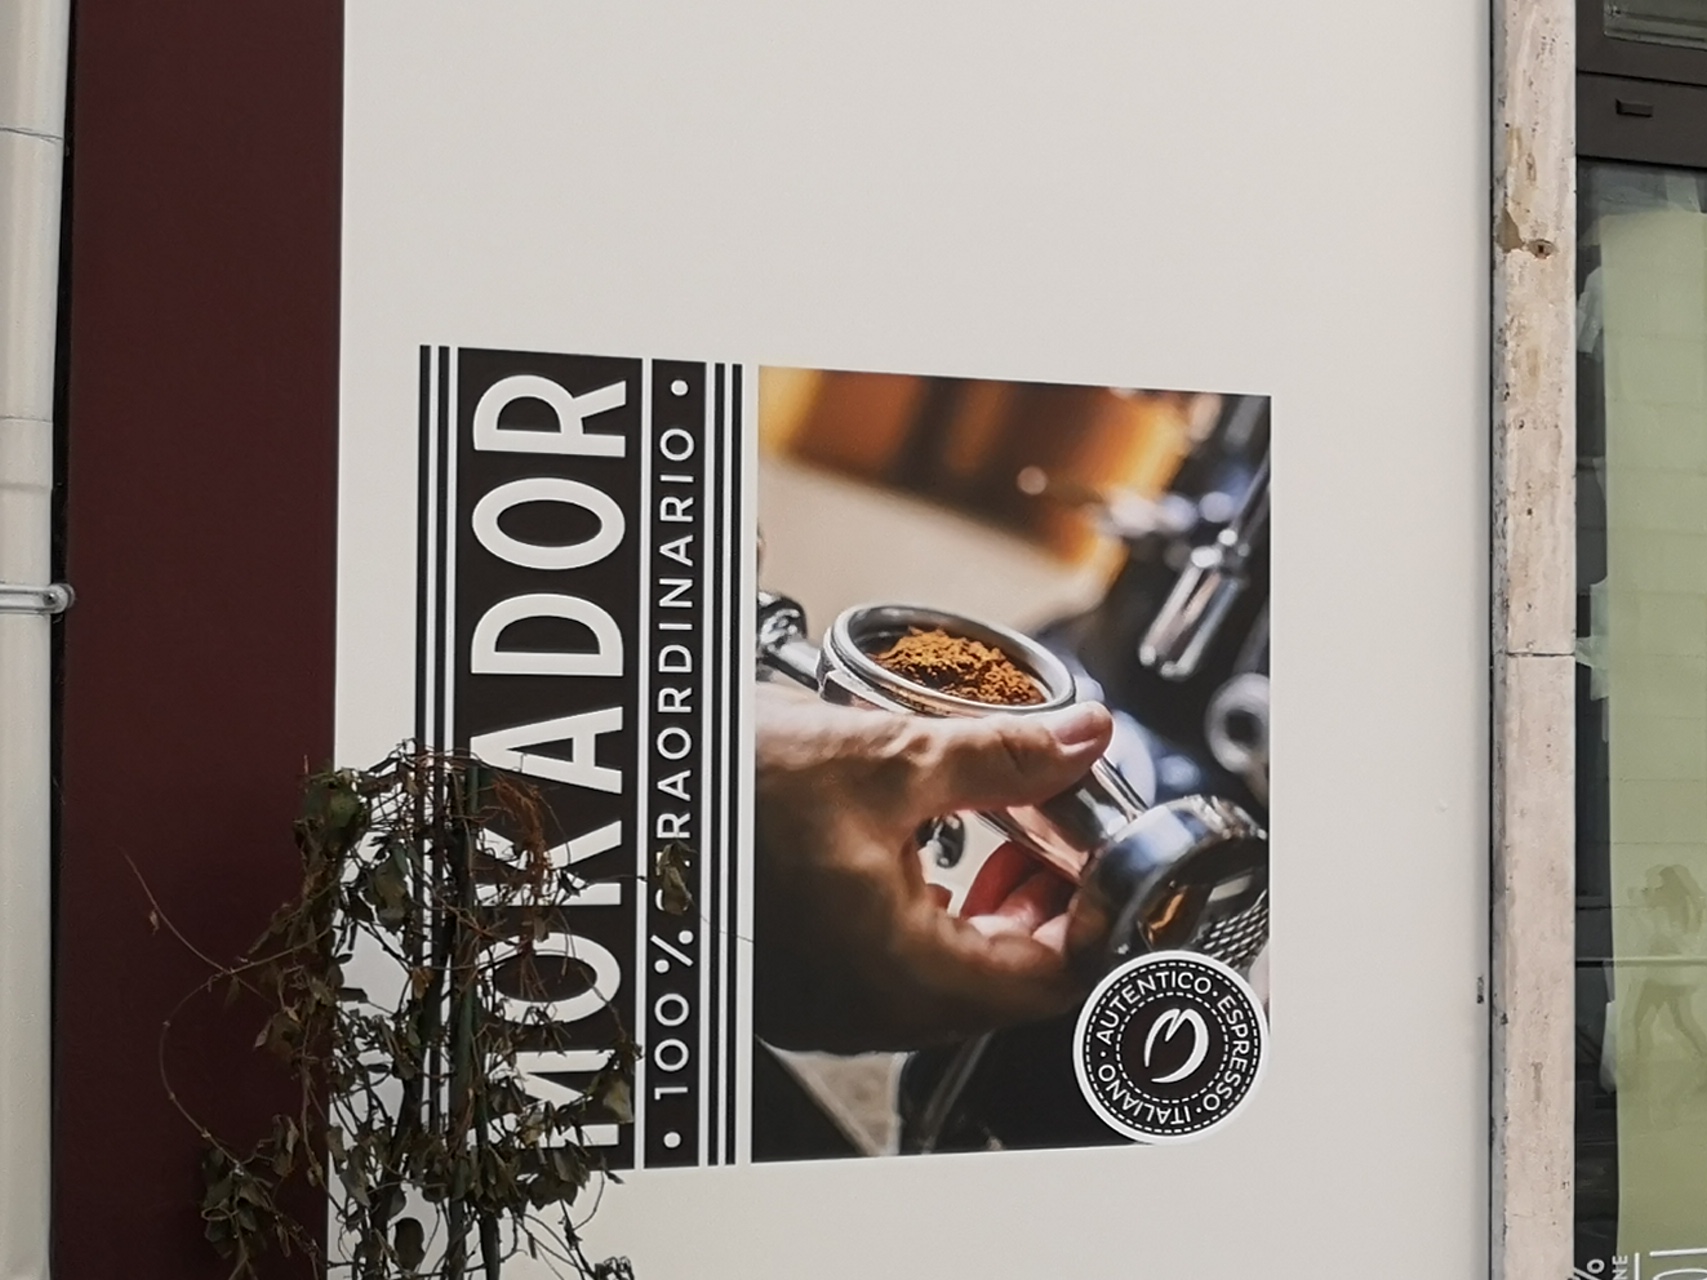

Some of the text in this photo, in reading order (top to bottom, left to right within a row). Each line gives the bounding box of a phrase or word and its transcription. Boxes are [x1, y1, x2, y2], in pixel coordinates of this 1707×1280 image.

[651, 929, 695, 1100] 100%
[1096, 971, 1250, 1124] AUTENTICO ESPRESSO ITALIANO
